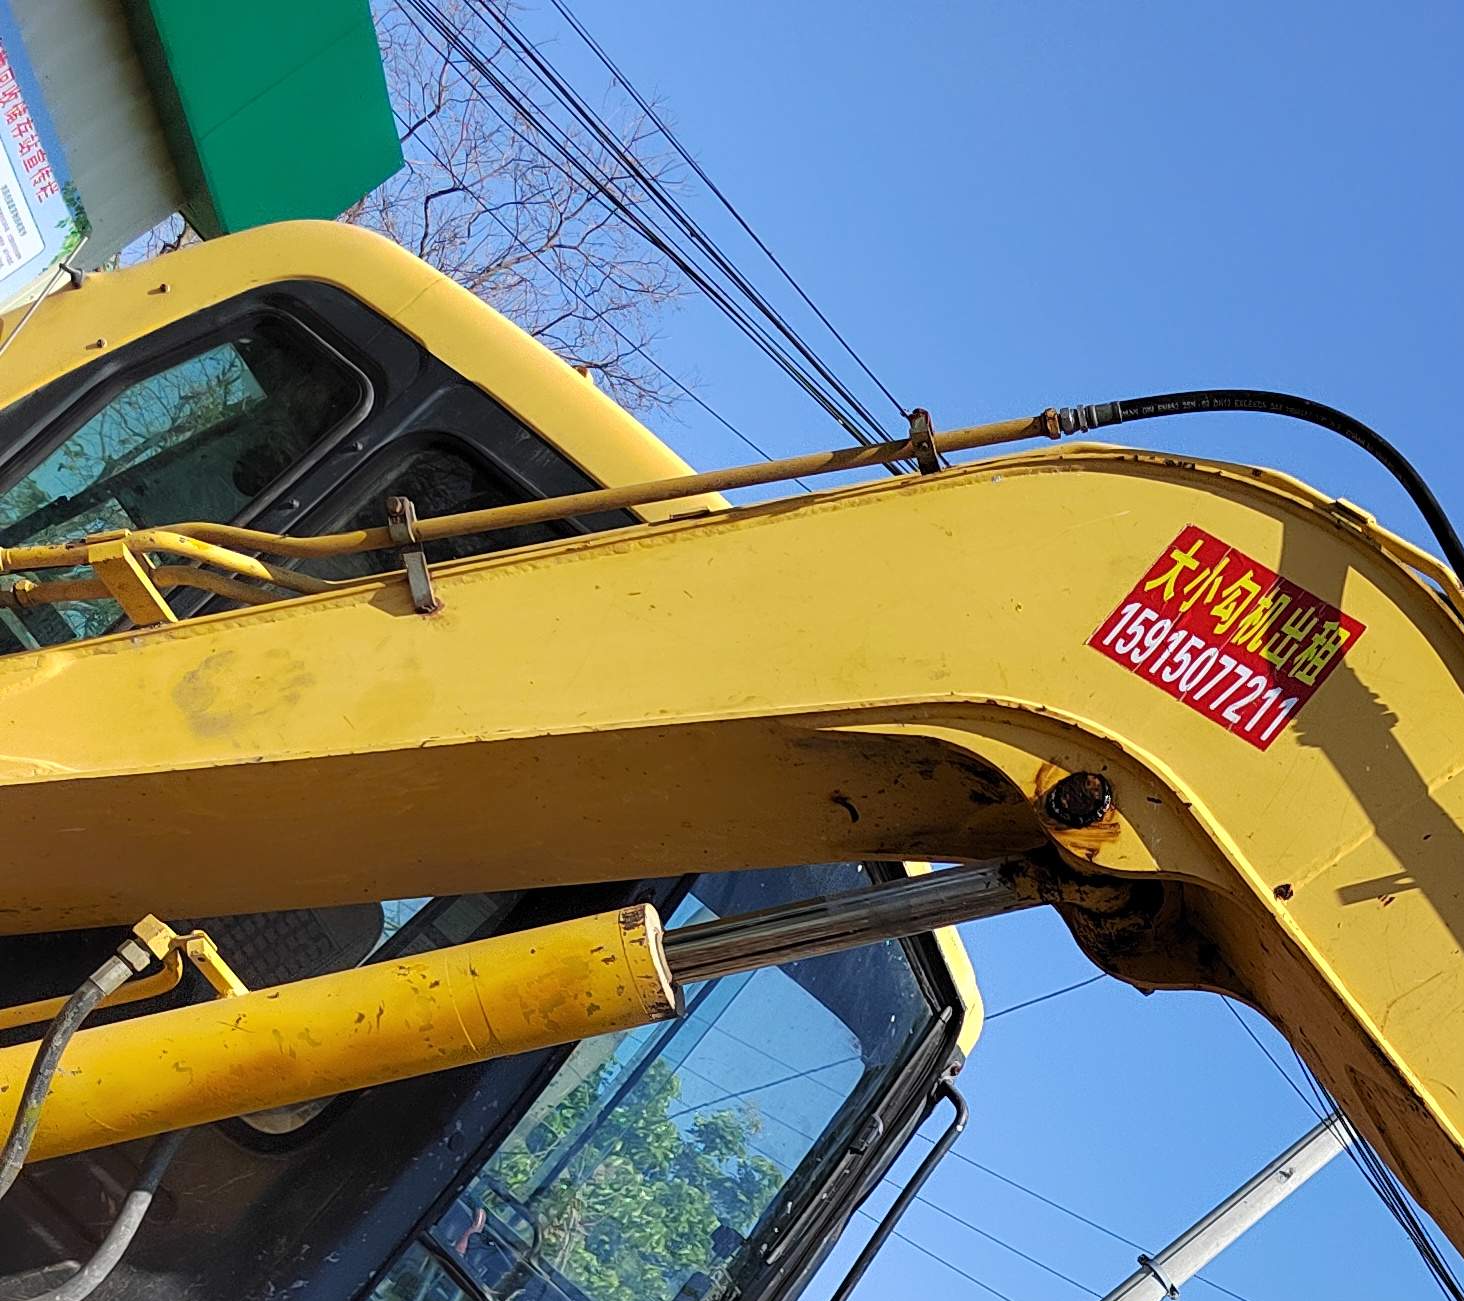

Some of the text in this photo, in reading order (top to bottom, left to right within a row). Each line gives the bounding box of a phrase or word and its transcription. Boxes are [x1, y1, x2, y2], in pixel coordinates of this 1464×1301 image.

[1102, 602, 1300, 741] 15915077211
[1144, 539, 1350, 686] 大小勾机出租
